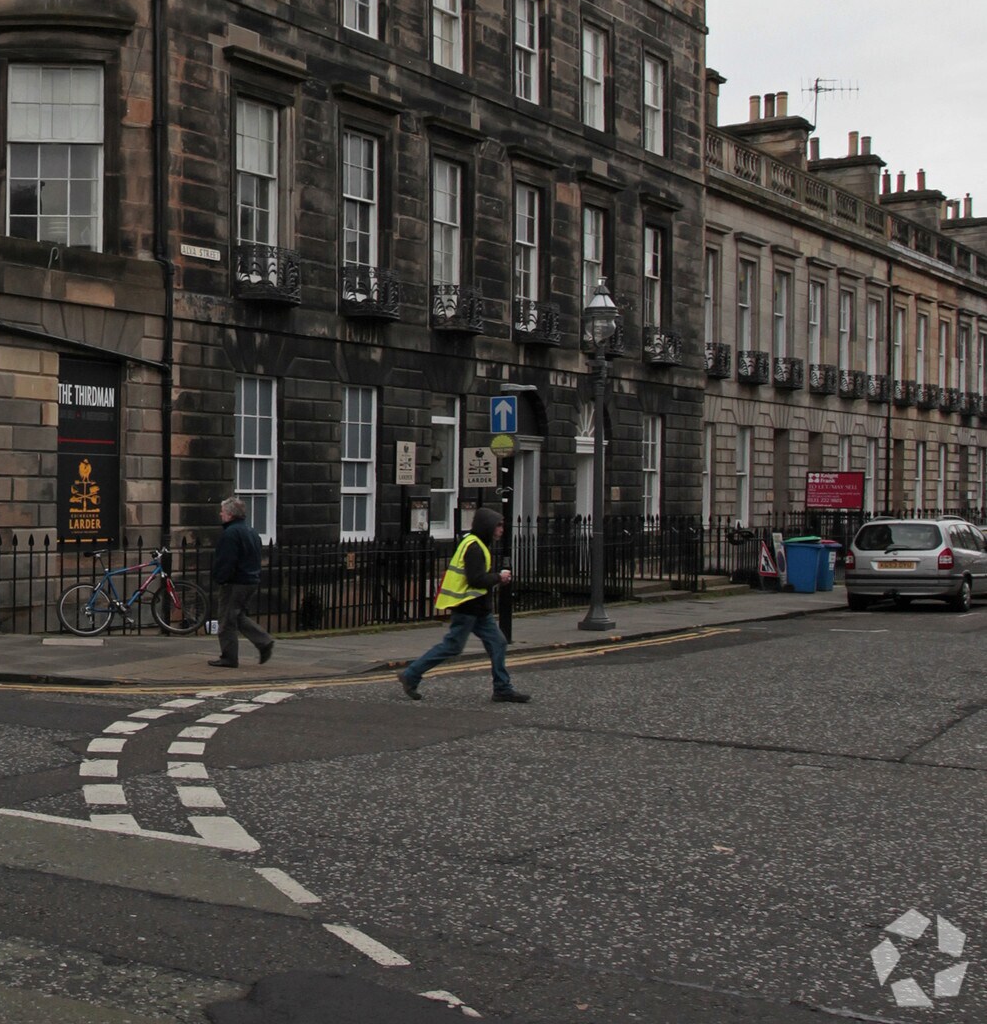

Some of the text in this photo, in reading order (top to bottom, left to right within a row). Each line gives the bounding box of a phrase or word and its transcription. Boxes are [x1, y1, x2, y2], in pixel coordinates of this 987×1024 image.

[199, 248, 220, 260] STREET
[58, 383, 73, 405] THE
[69, 518, 102, 529] LARDER
